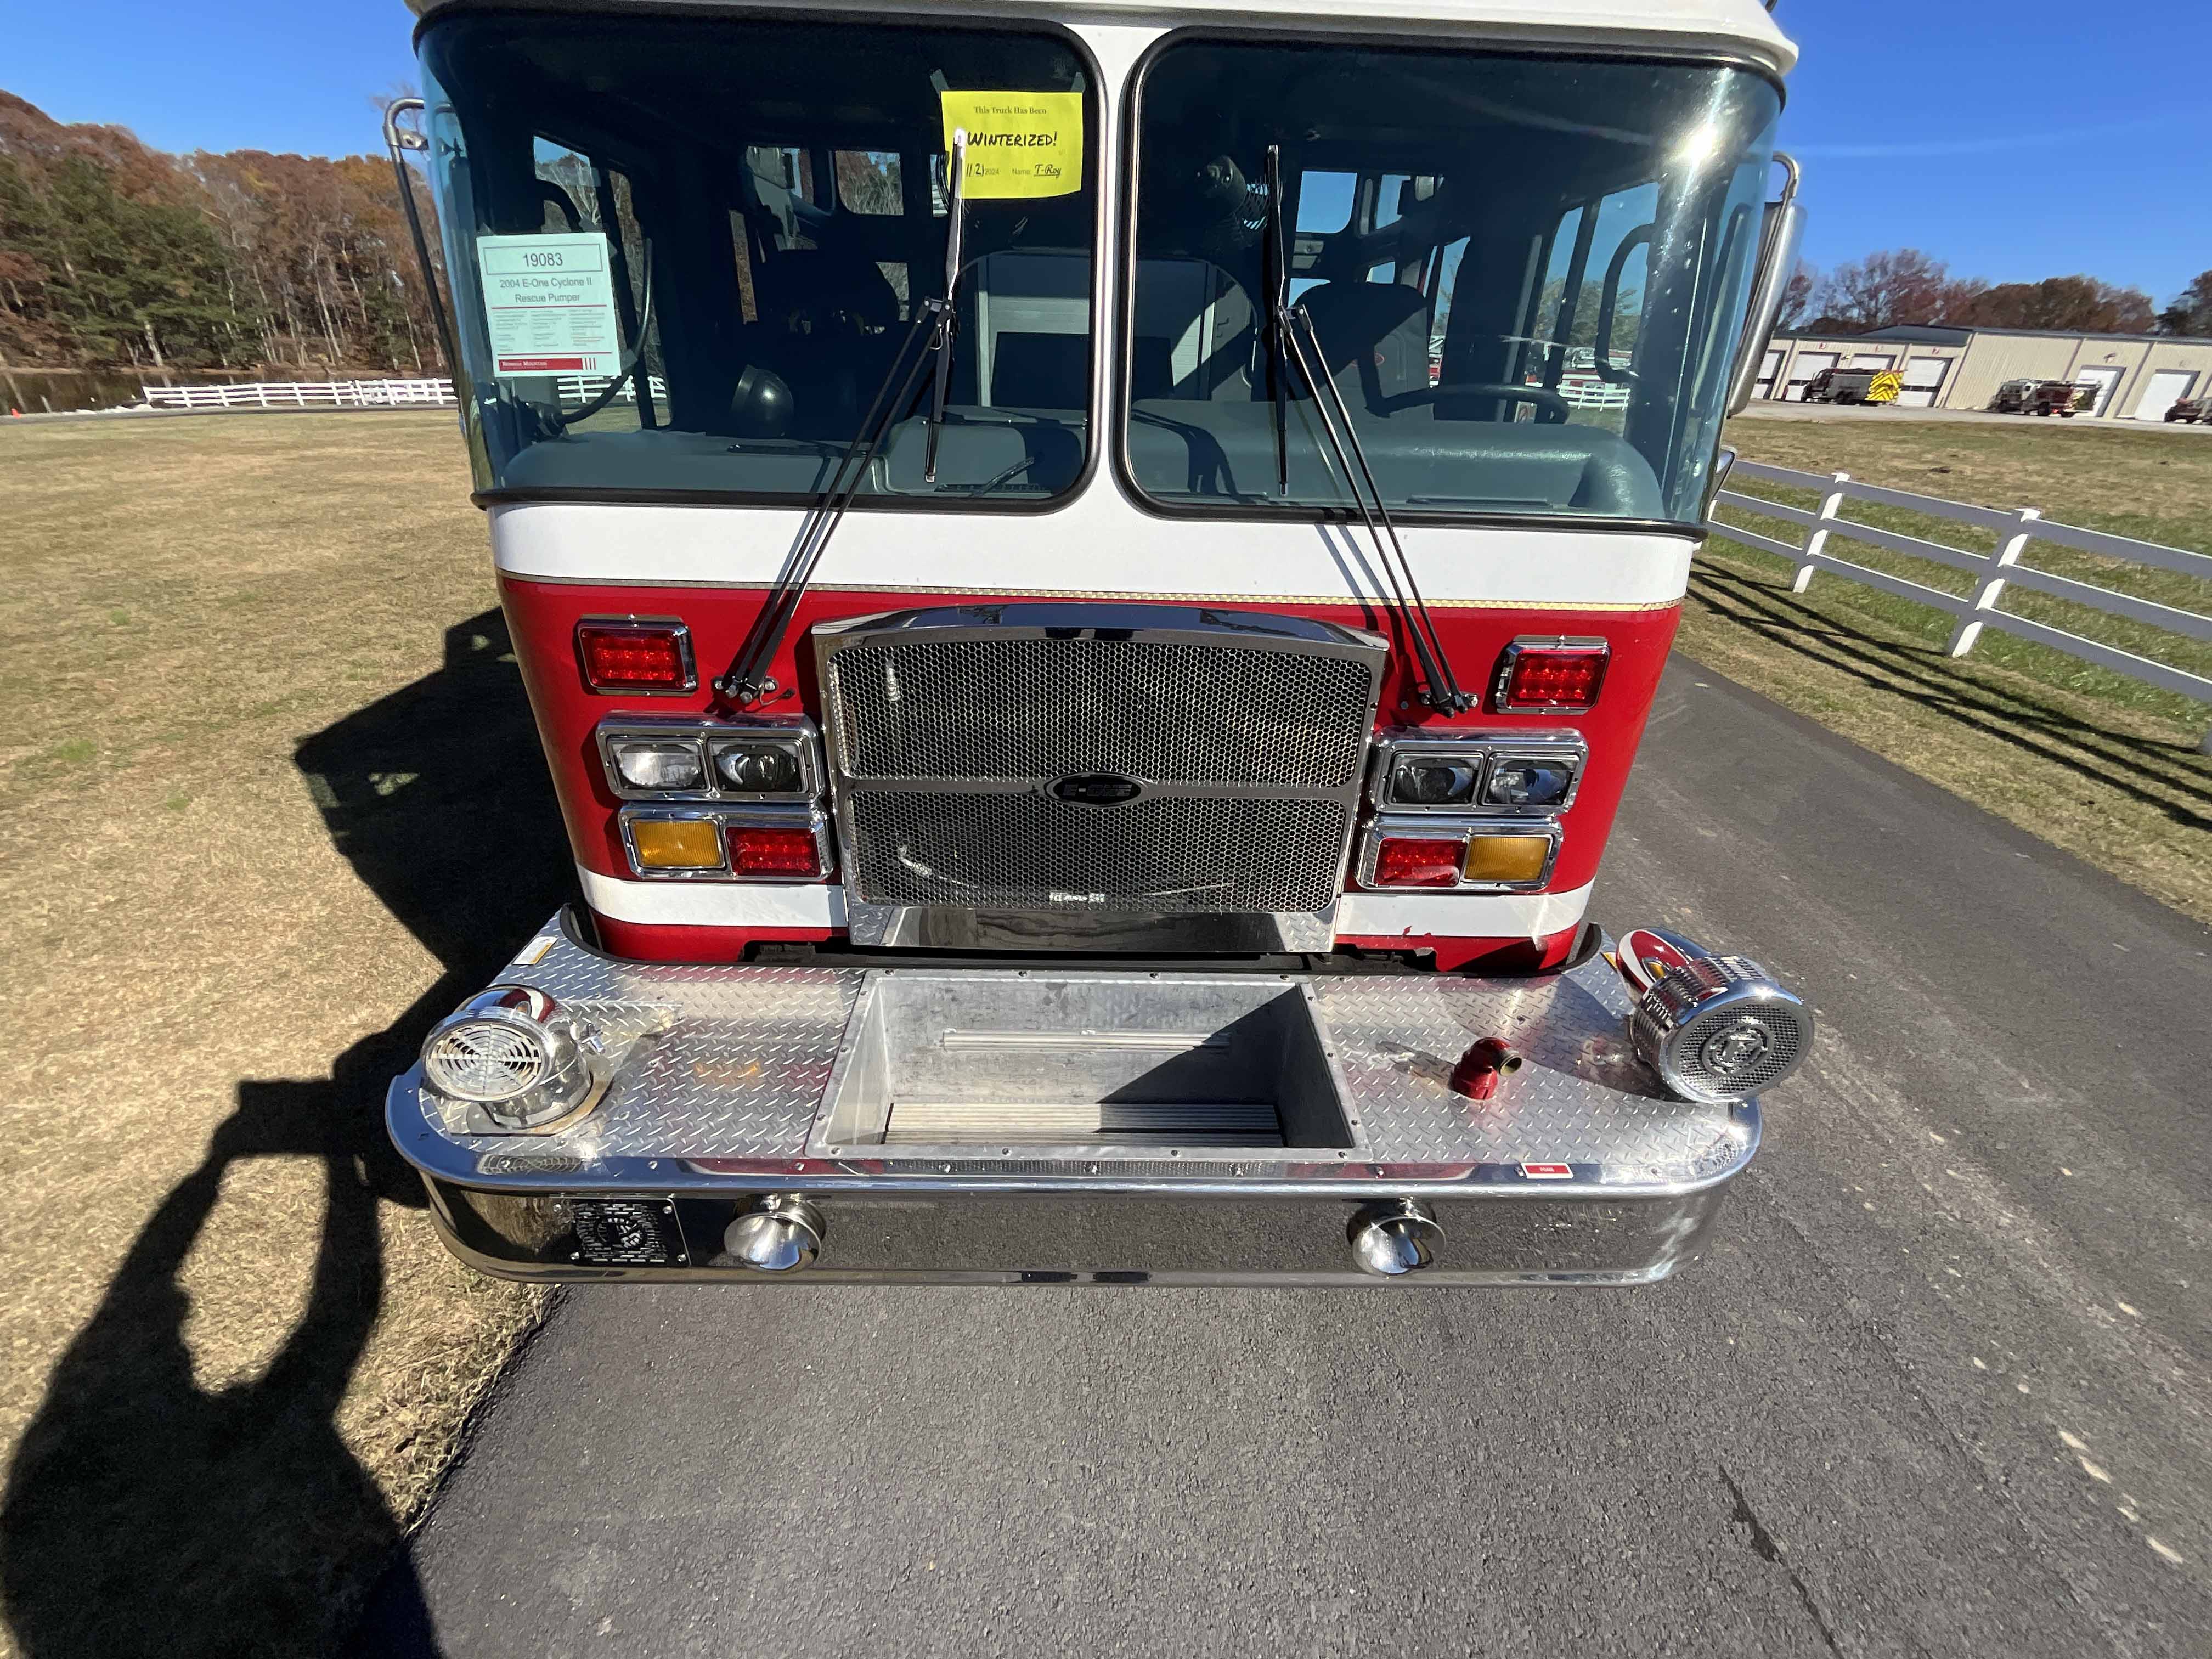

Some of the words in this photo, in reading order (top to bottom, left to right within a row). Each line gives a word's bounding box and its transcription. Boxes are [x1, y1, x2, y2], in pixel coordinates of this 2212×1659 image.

[967, 131, 1057, 146] WINTERIZED!
[1034, 163, 1062, 179] T-Roy
[523, 252, 563, 267] 19083
[500, 279, 520, 289] 2004
[522, 278, 549, 288] E-One
[551, 277, 584, 289] Cyclone
[515, 294, 546, 303] Rescue
[549, 292, 580, 303] Pumper
